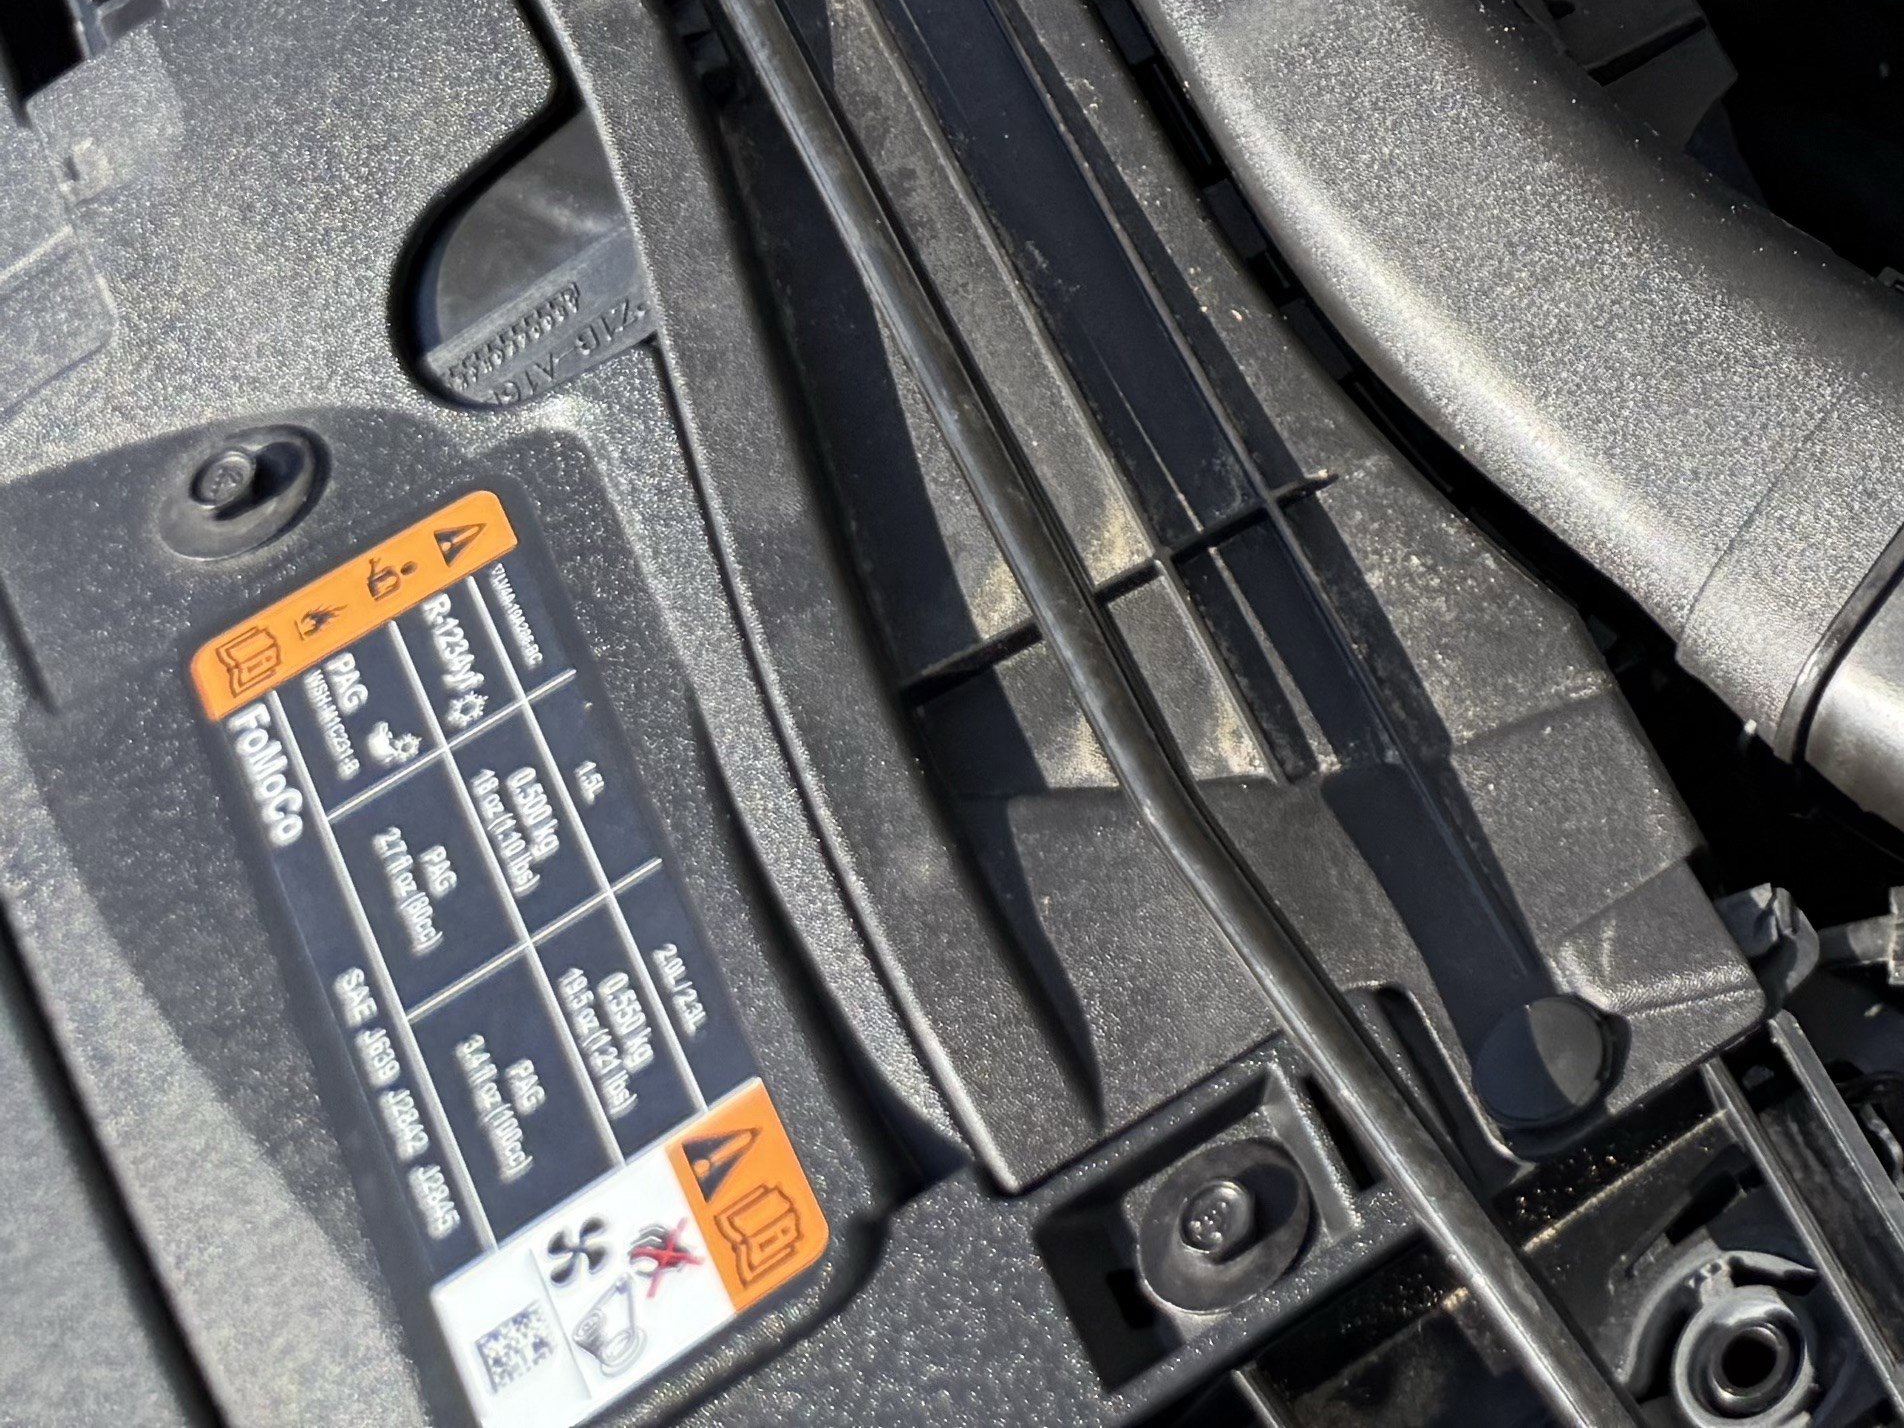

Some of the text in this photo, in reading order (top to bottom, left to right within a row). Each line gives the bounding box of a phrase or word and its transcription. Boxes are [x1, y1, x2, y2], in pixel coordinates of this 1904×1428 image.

[418, 591, 484, 695] R-1234yf
[323, 651, 371, 714] PAG
[225, 702, 314, 847] FoMoCo
[370, 825, 407, 860] 2.7
[469, 767, 543, 896] 18 oz (1.10 lbs)
[502, 764, 565, 859] 0.500 kg
[391, 872, 417, 898] oz
[418, 844, 459, 897] PAG
[394, 890, 444, 955] (80cc)
[451, 1034, 492, 1077] 3.4
[554, 965, 641, 1119] 19.5 oz (1.21 lbs)
[594, 969, 663, 1075] 0.550 kg
[328, 966, 462, 1240] SAE J639 J2842 J2845
[476, 1089, 504, 1114] oz
[502, 1058, 548, 1114] PAG
[479, 1106, 535, 1182] (100cc)
